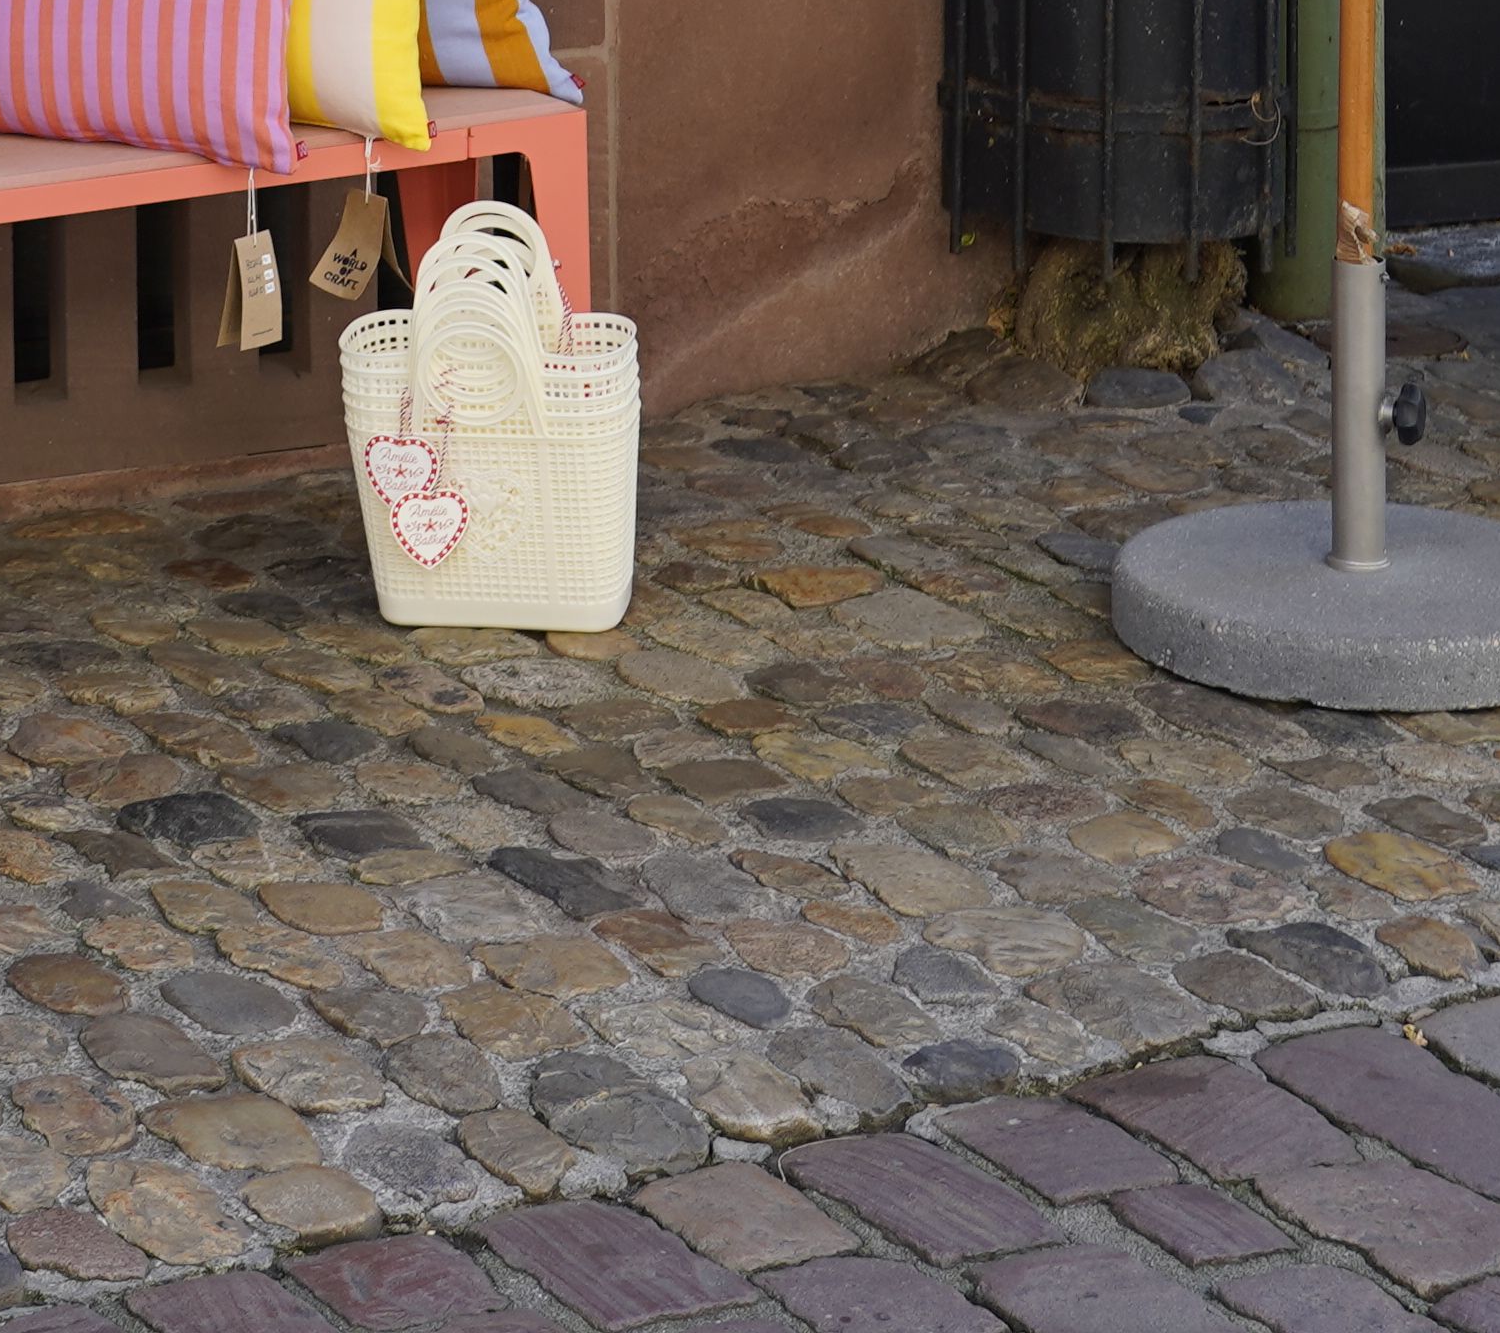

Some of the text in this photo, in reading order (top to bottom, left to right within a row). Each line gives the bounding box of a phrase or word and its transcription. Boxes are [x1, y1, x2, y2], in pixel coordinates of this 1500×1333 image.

[350, 249, 358, 258] A
[333, 252, 368, 271] WORLD
[339, 266, 352, 277] OF
